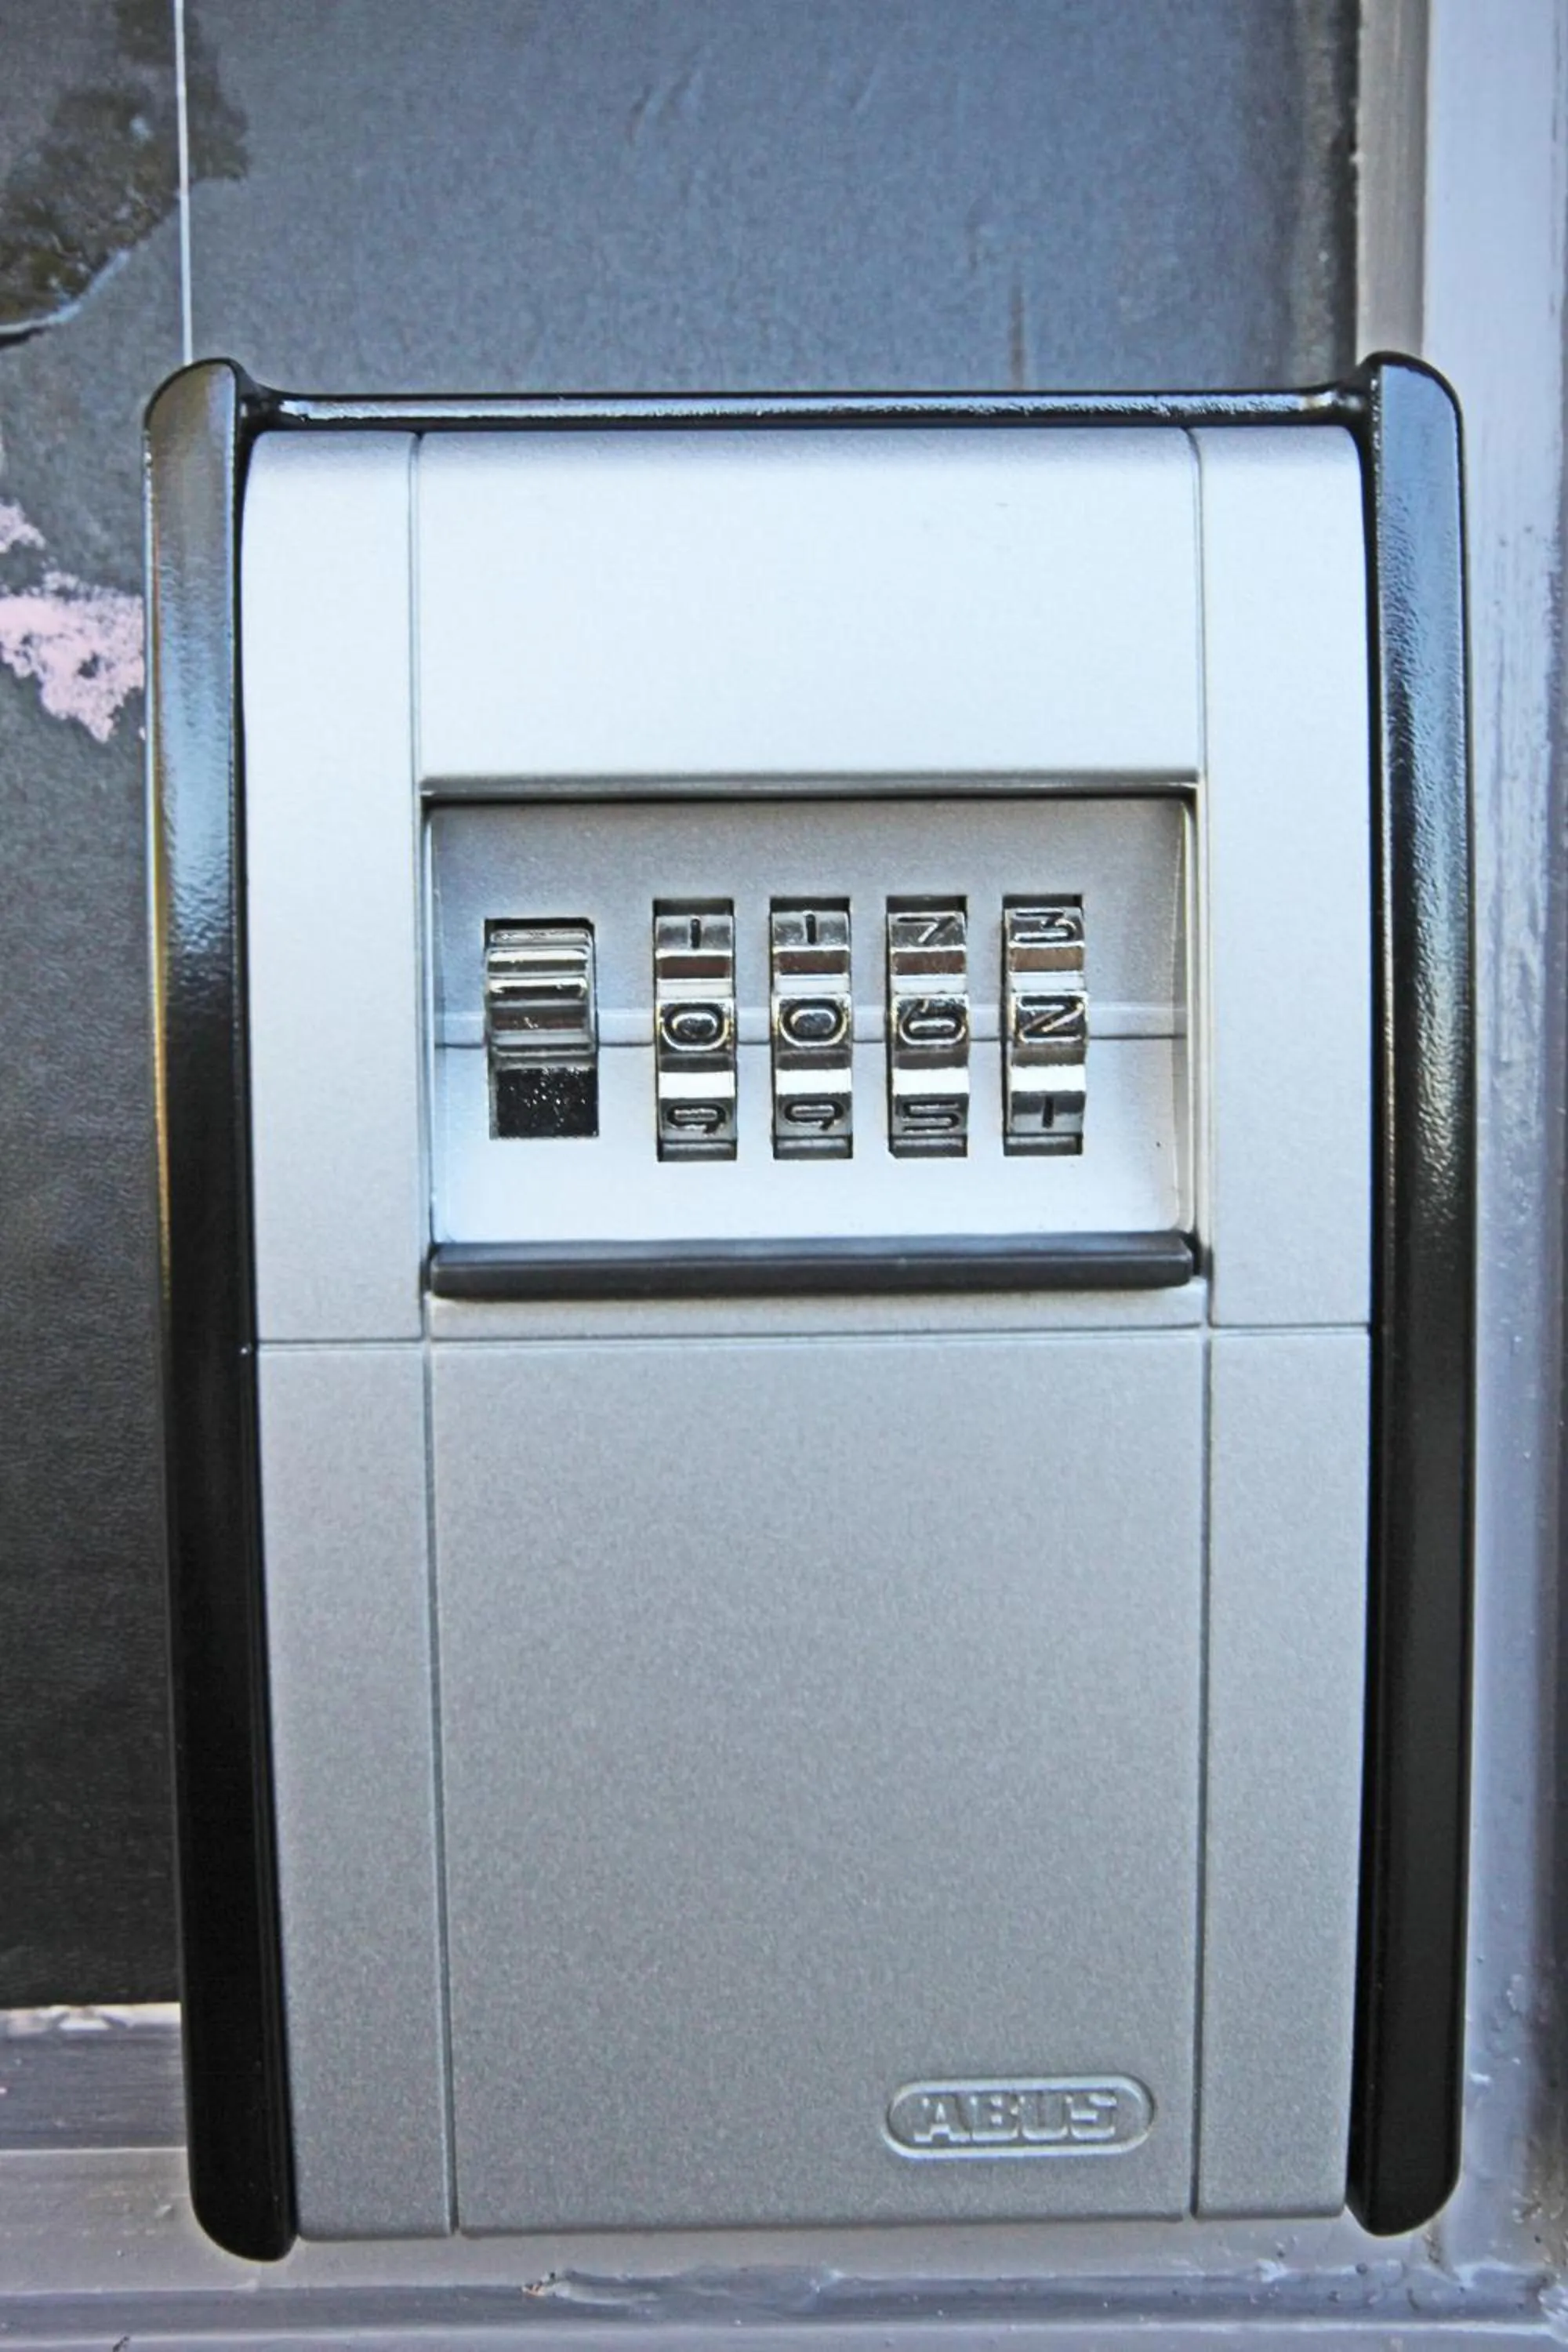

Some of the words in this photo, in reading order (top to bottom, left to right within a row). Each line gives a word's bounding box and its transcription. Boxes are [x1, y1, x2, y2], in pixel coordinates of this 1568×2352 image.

[896, 914, 957, 946] 7
[1014, 909, 1077, 944] 3
[899, 998, 966, 1045] 6
[1018, 994, 1085, 1044] 2
[666, 1102, 728, 1134] 9
[785, 1100, 844, 1131] 9
[902, 1099, 960, 1131] 5
[913, 2089, 1118, 2143] ABUS
